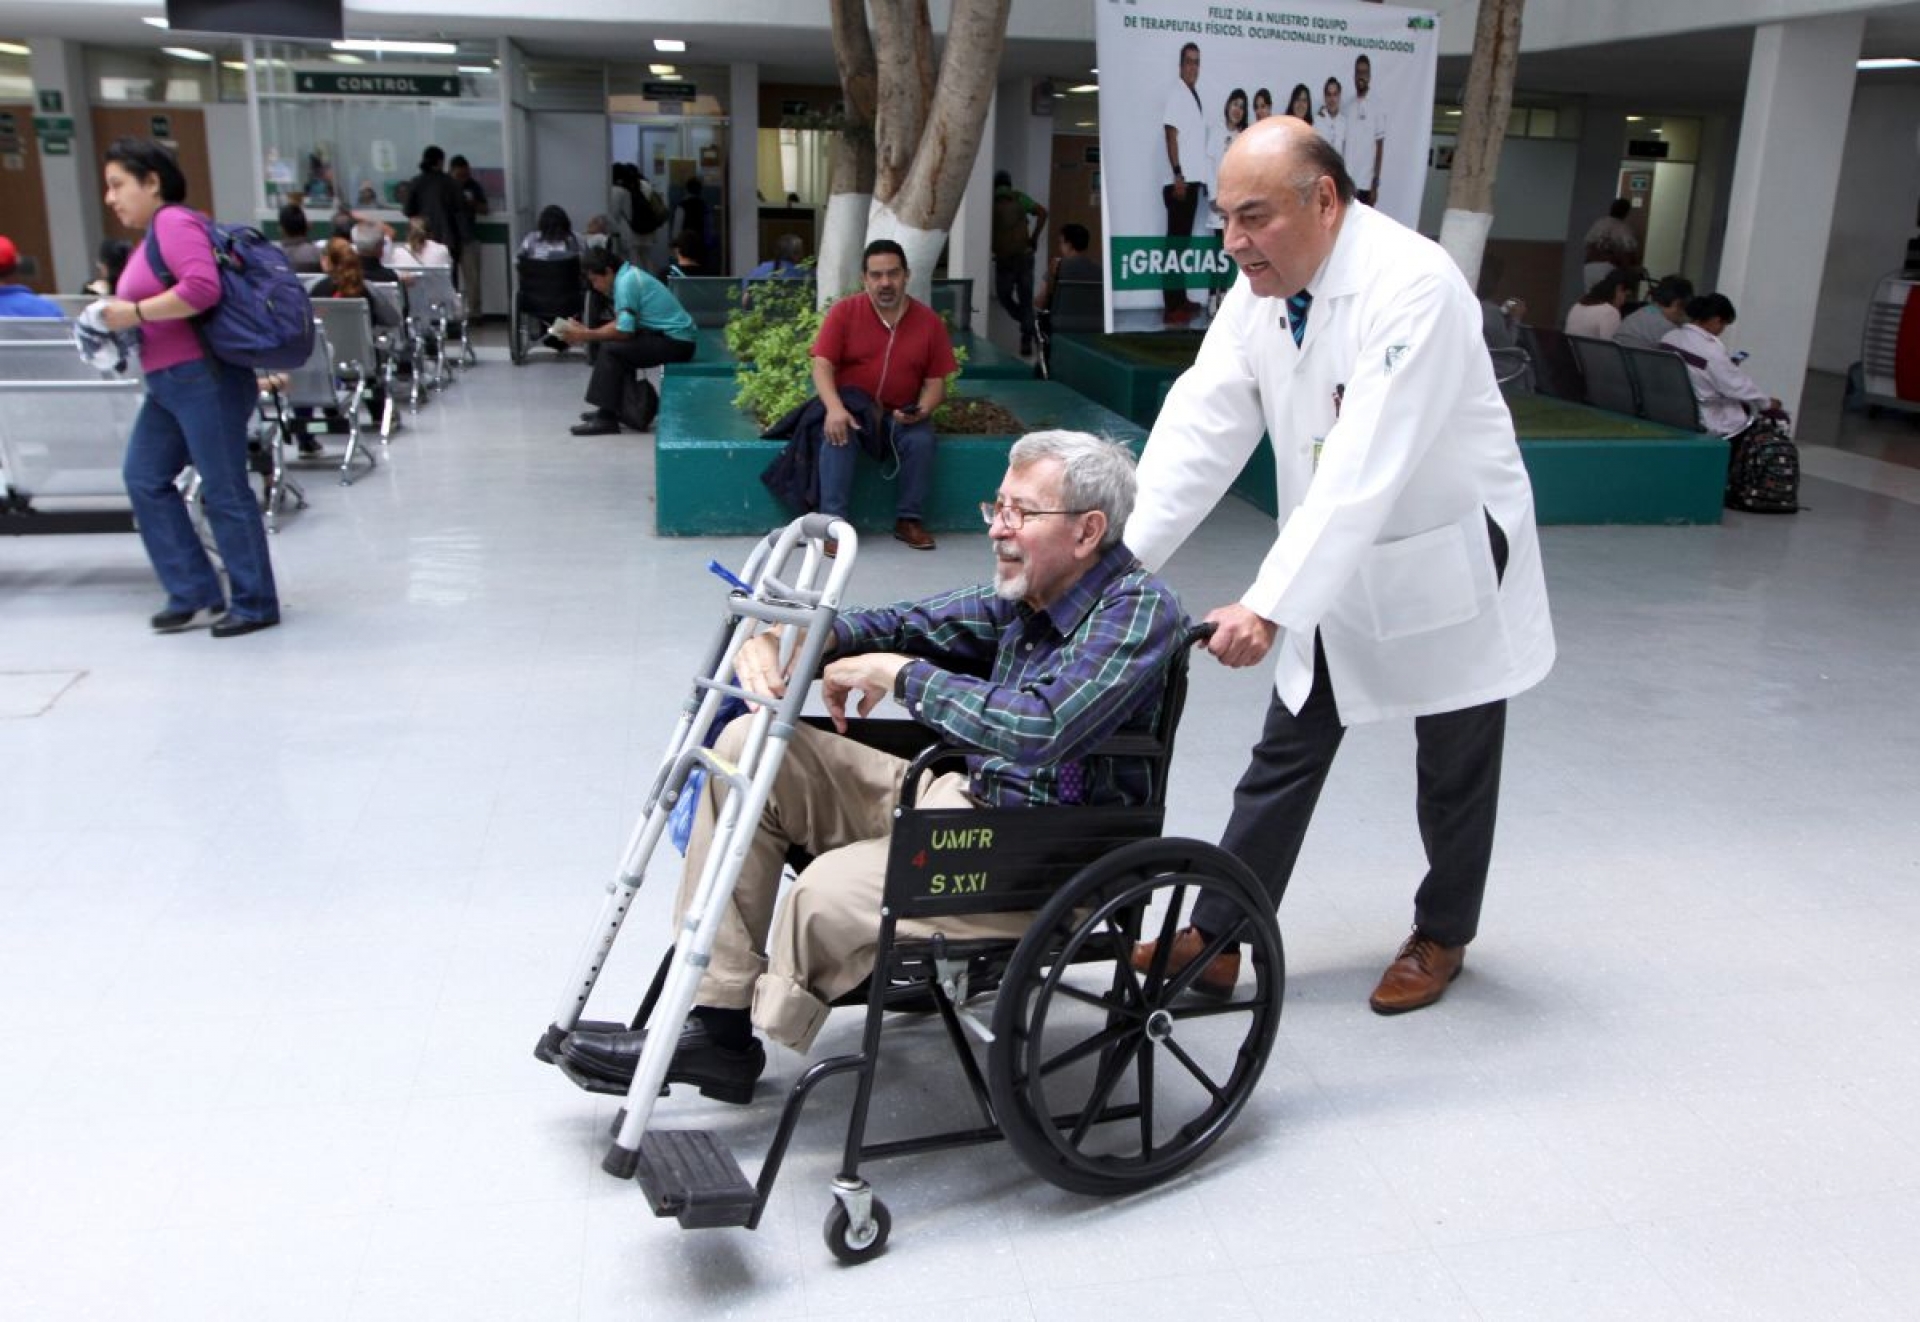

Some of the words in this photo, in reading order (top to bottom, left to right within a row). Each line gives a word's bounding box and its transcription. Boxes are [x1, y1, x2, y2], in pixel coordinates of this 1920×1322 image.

[1208, 7, 1233, 20] FELIZ
[1236, 7, 1254, 21] DÍA
[1256, 12, 1263, 22] A
[1266, 12, 1310, 27] NUESTRO
[1312, 16, 1348, 31] EQUIPO
[1124, 15, 1137, 28] DE
[1141, 16, 1202, 33] TERAPEUTAS
[1248, 26, 1327, 45] OCUPACIONALES
[1329, 34, 1335, 46] Y
[304, 77, 314, 89] 4
[336, 76, 420, 92] CONTROL
[442, 80, 452, 91] 4
[1121, 248, 1230, 280] ¡GRACIAS
[931, 828, 993, 850] UMFR
[912, 850, 928, 868] 4
[930, 873, 945, 894] S
[951, 872, 987, 894] XXI
